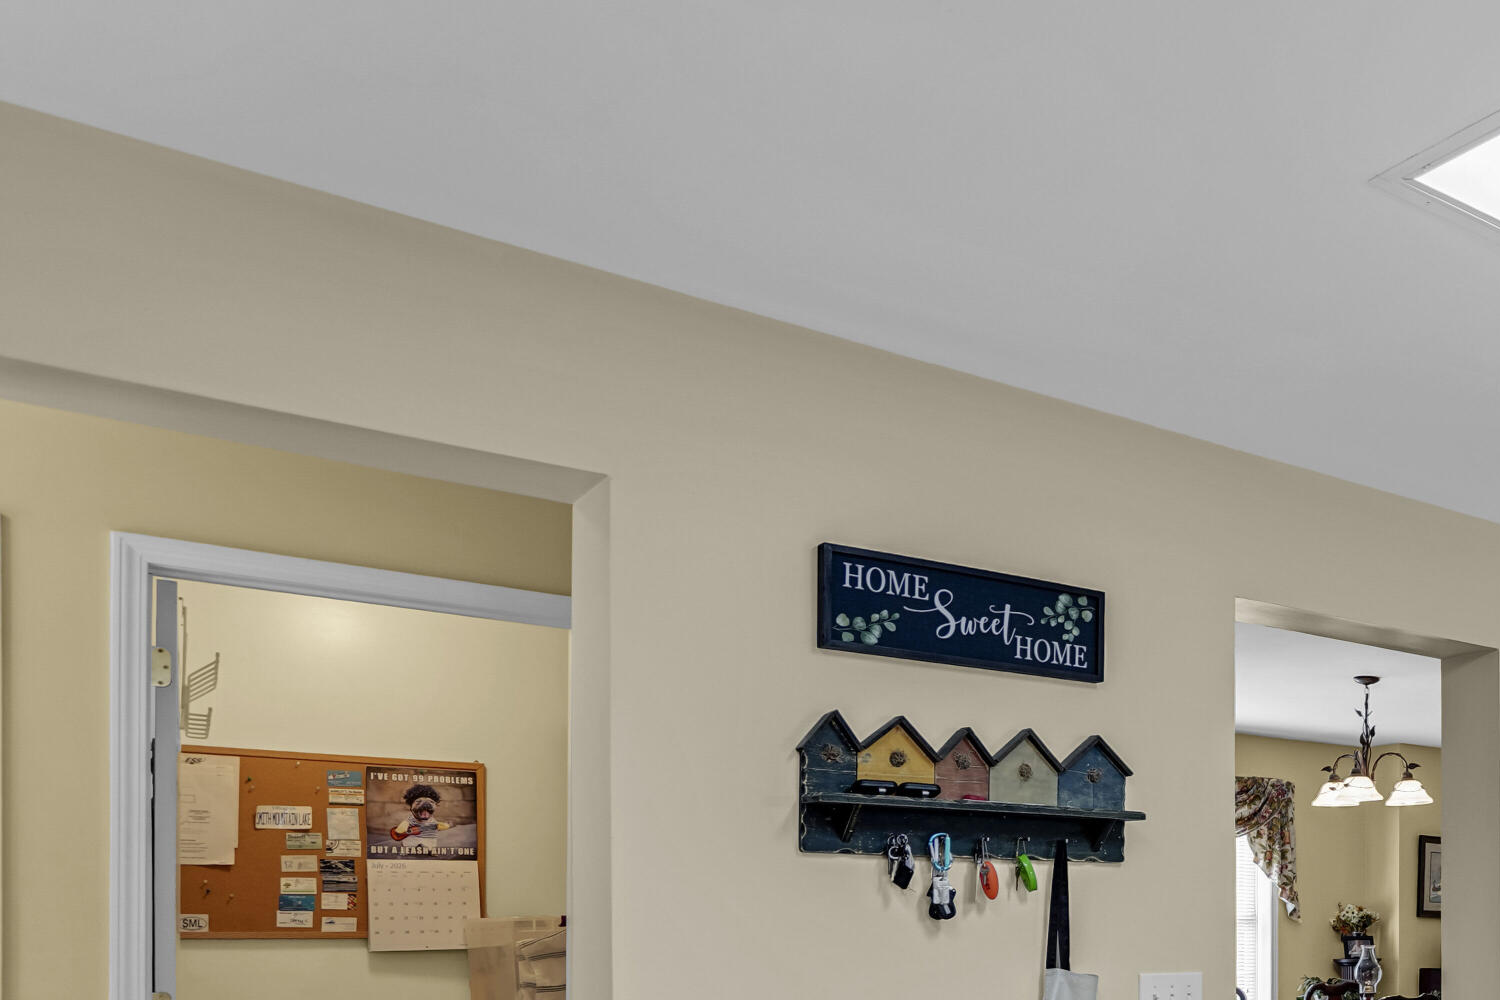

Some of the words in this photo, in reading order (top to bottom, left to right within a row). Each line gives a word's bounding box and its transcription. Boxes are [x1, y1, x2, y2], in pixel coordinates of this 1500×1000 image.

[842, 561, 929, 600] HOME
[903, 589, 1035, 646] Sweet
[1014, 635, 1088, 669] HOME
[370, 772, 389, 780] I'VE
[391, 773, 409, 782] GOT
[412, 774, 424, 782] 99
[427, 775, 474, 785] PROBLEMS
[256, 811, 272, 825] SMITH
[272, 811, 298, 826] MOUNTAIN
[299, 812, 311, 826] LAKE
[370, 845, 388, 854] BUT
[391, 846, 398, 854] A
[400, 846, 428, 855] LEASH
[431, 847, 455, 855] AIN'T
[457, 847, 474, 856] ONE
[182, 918, 203, 928] SML
